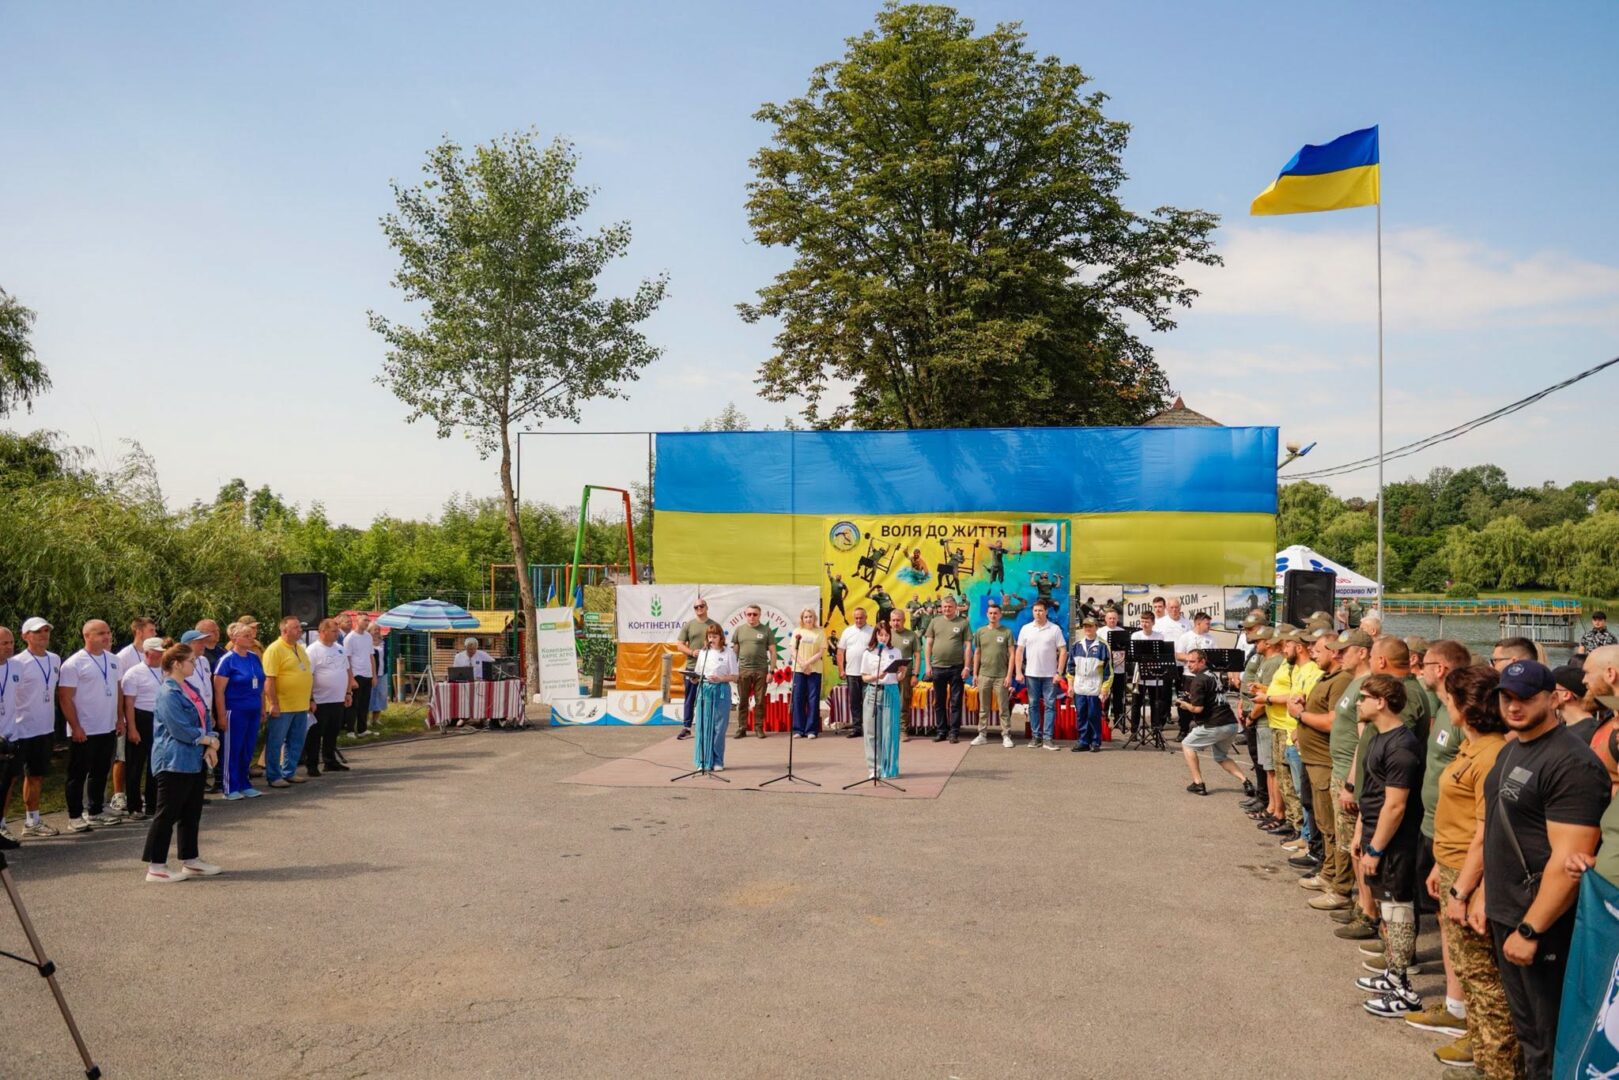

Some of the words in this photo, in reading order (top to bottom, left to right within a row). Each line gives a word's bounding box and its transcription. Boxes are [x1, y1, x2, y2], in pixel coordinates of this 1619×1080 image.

[881, 525, 922, 537] ВОЛЯ
[926, 525, 948, 539] ДО
[952, 525, 1007, 538] ЖИТТЯ
[1127, 602, 1153, 617] Силь
[1180, 593, 1199, 606] хом
[575, 701, 586, 717] 2
[630, 695, 638, 712] 1
